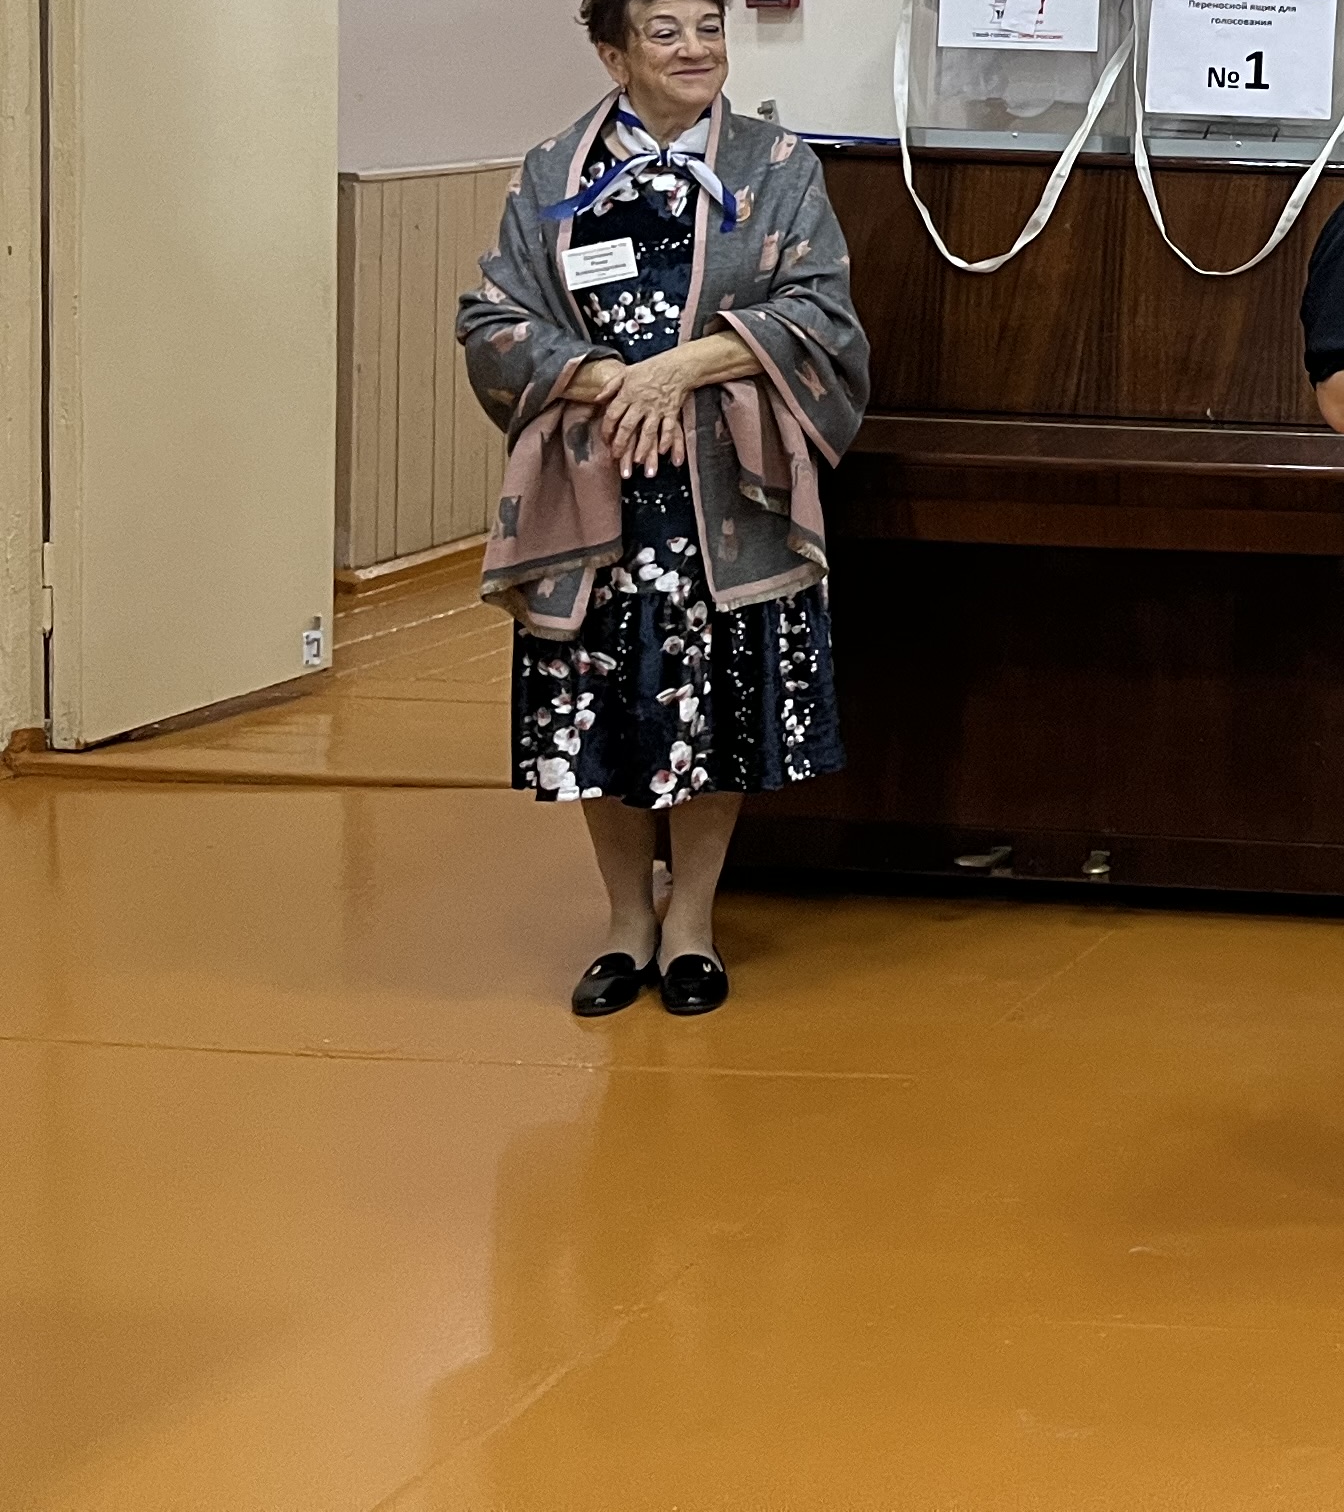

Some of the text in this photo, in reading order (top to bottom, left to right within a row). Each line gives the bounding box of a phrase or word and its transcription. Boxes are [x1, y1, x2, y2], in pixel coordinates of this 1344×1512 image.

[1188, 0, 1297, 14] Переносной ящик для
[1210, 16, 1273, 27] голосования
